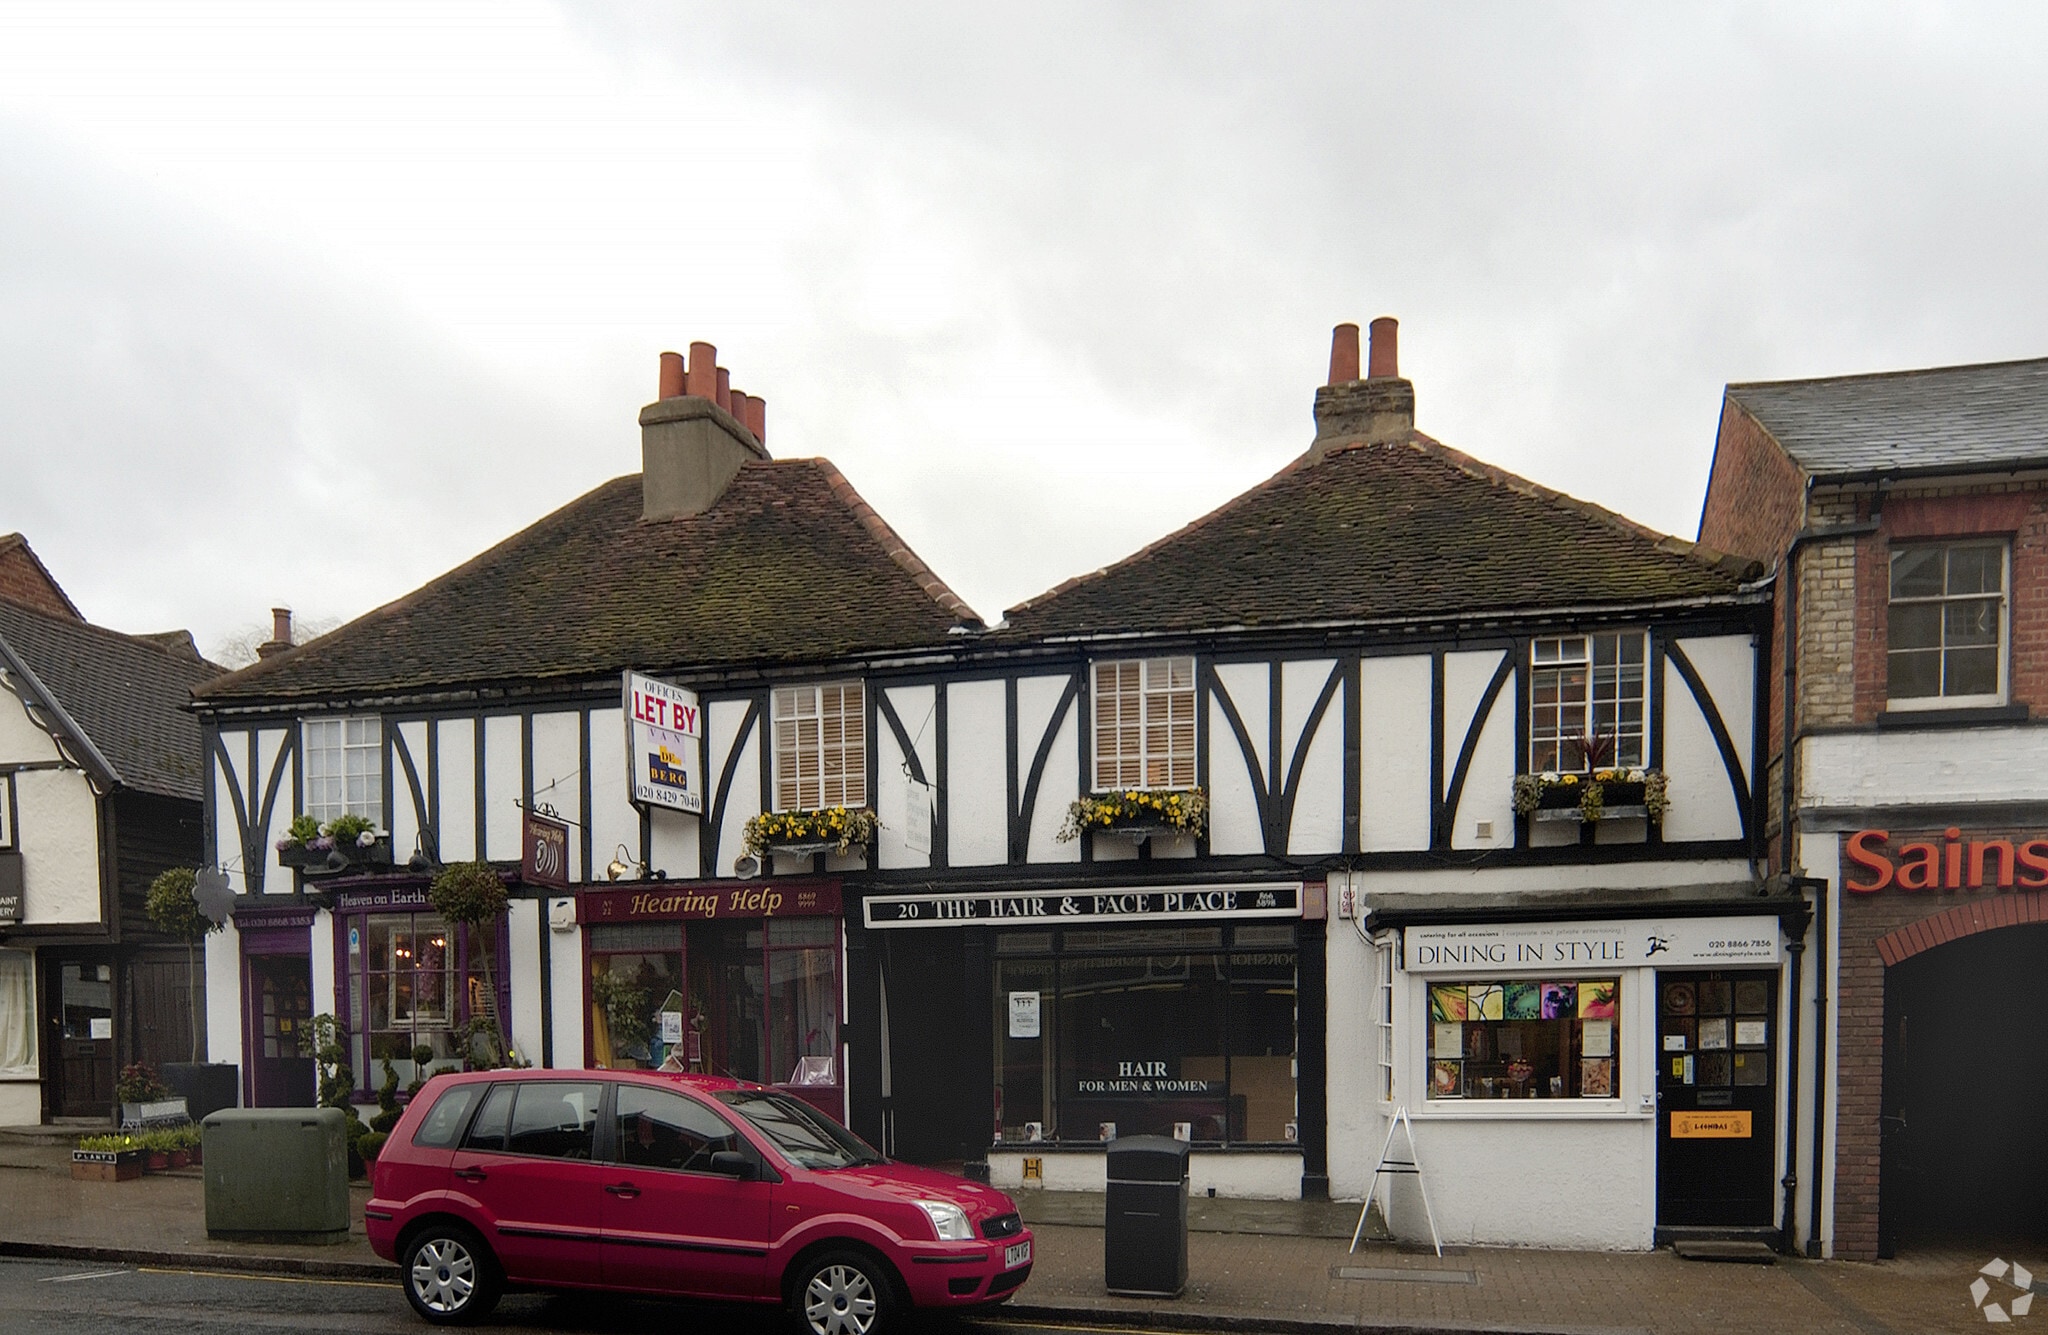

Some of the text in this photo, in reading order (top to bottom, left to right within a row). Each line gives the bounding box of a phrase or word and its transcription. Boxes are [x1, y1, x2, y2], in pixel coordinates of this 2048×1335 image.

[645, 681, 683, 701] OFFICES
[634, 690, 697, 734] LET BY
[651, 768, 686, 786] BERG
[637, 785, 700, 810] 020 8429 7040
[340, 888, 426, 907] Heaven on Earth
[630, 887, 783, 919] Hearing Help
[898, 891, 1238, 919] 20 THE HAIR & FACE PLACE
[1419, 940, 1625, 964] DINING IN STYLE
[1708, 940, 1726, 949] 020
[1118, 1061, 1168, 1077] HAIR
[1078, 1081, 1208, 1091] FOR MEN & WOMEN
